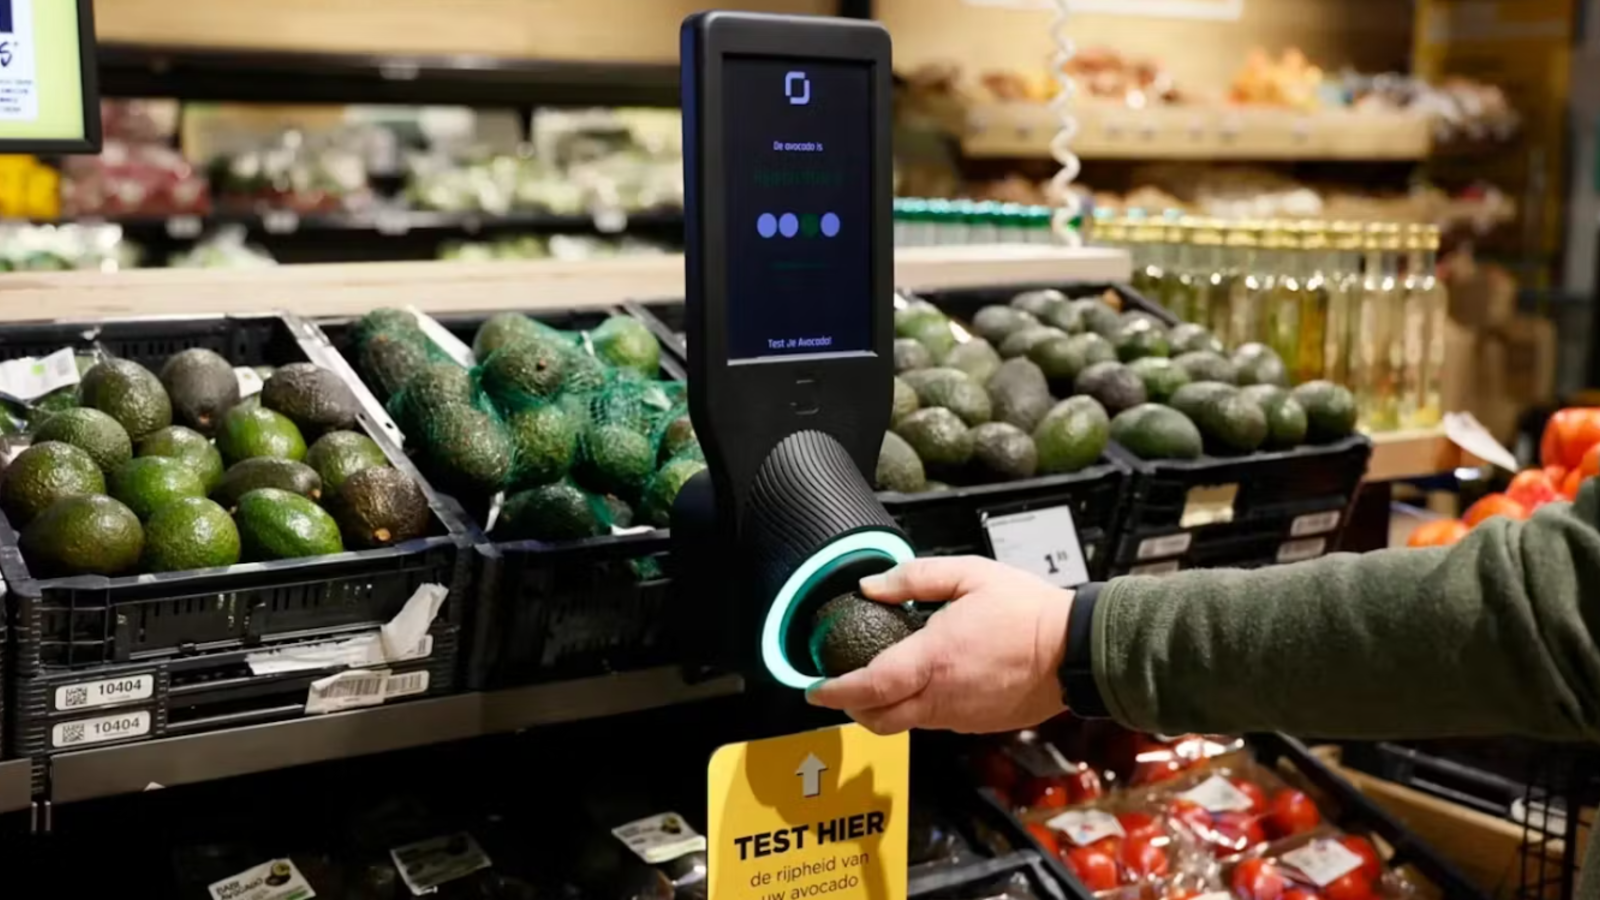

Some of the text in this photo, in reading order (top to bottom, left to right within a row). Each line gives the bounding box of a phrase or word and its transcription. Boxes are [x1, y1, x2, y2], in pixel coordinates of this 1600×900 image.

[773, 140, 824, 151] De avocado is
[768, 338, 785, 348] Test
[786, 338, 797, 348] Je
[98, 679, 142, 695] 10404
[94, 717, 140, 734] 10404
[734, 811, 885, 860] TEST HIER
[750, 853, 869, 887] de rijpheid van
[790, 874, 859, 900] avocado
